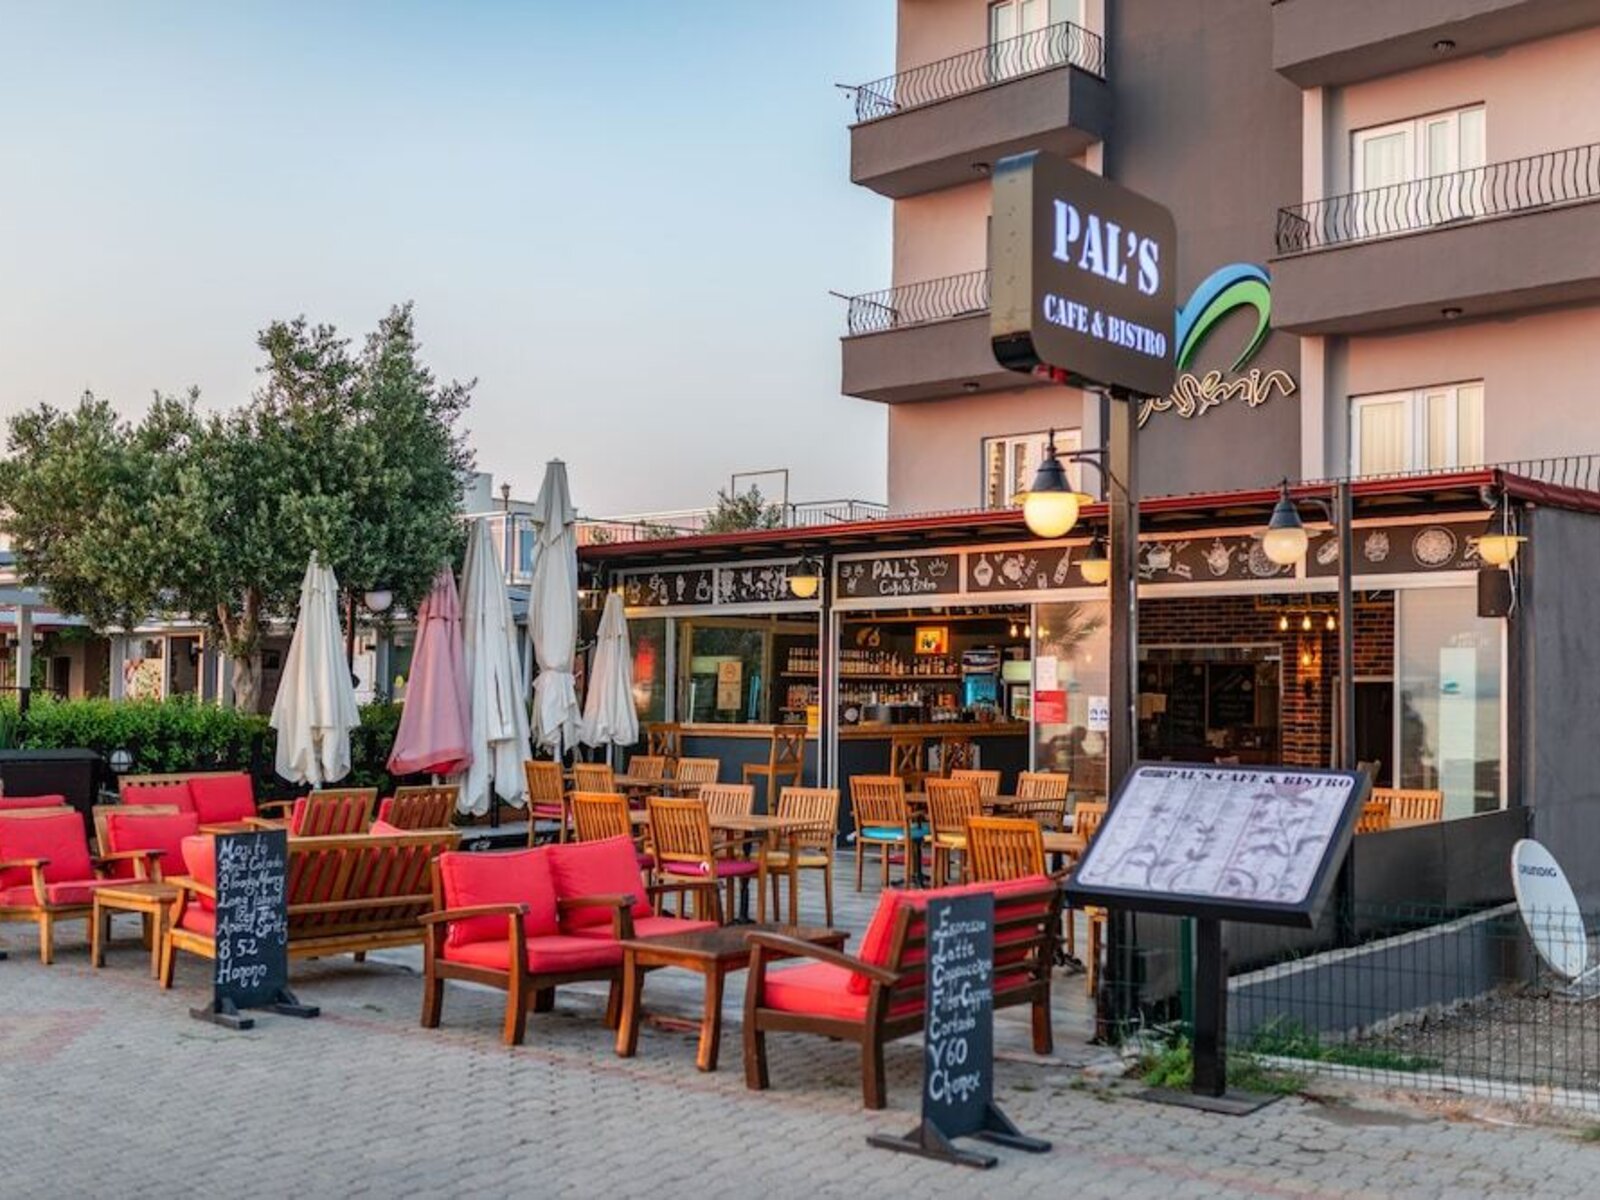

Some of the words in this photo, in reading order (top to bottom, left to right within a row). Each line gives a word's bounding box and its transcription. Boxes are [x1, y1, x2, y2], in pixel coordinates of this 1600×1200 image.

[1053, 199, 1159, 295] PAL'S
[1044, 294, 1089, 332] CAFE
[1090, 312, 1105, 338] &
[1107, 317, 1168, 359] BISTRO
[871, 558, 920, 581] PAL'S
[1215, 773, 1260, 784] CAFE
[1265, 774, 1276, 785] &
[1282, 776, 1352, 788] BISTRO
[218, 834, 269, 861] Mojito
[235, 938, 259, 958] 52
[931, 938, 976, 965] Latte
[928, 1036, 969, 1069] V60
